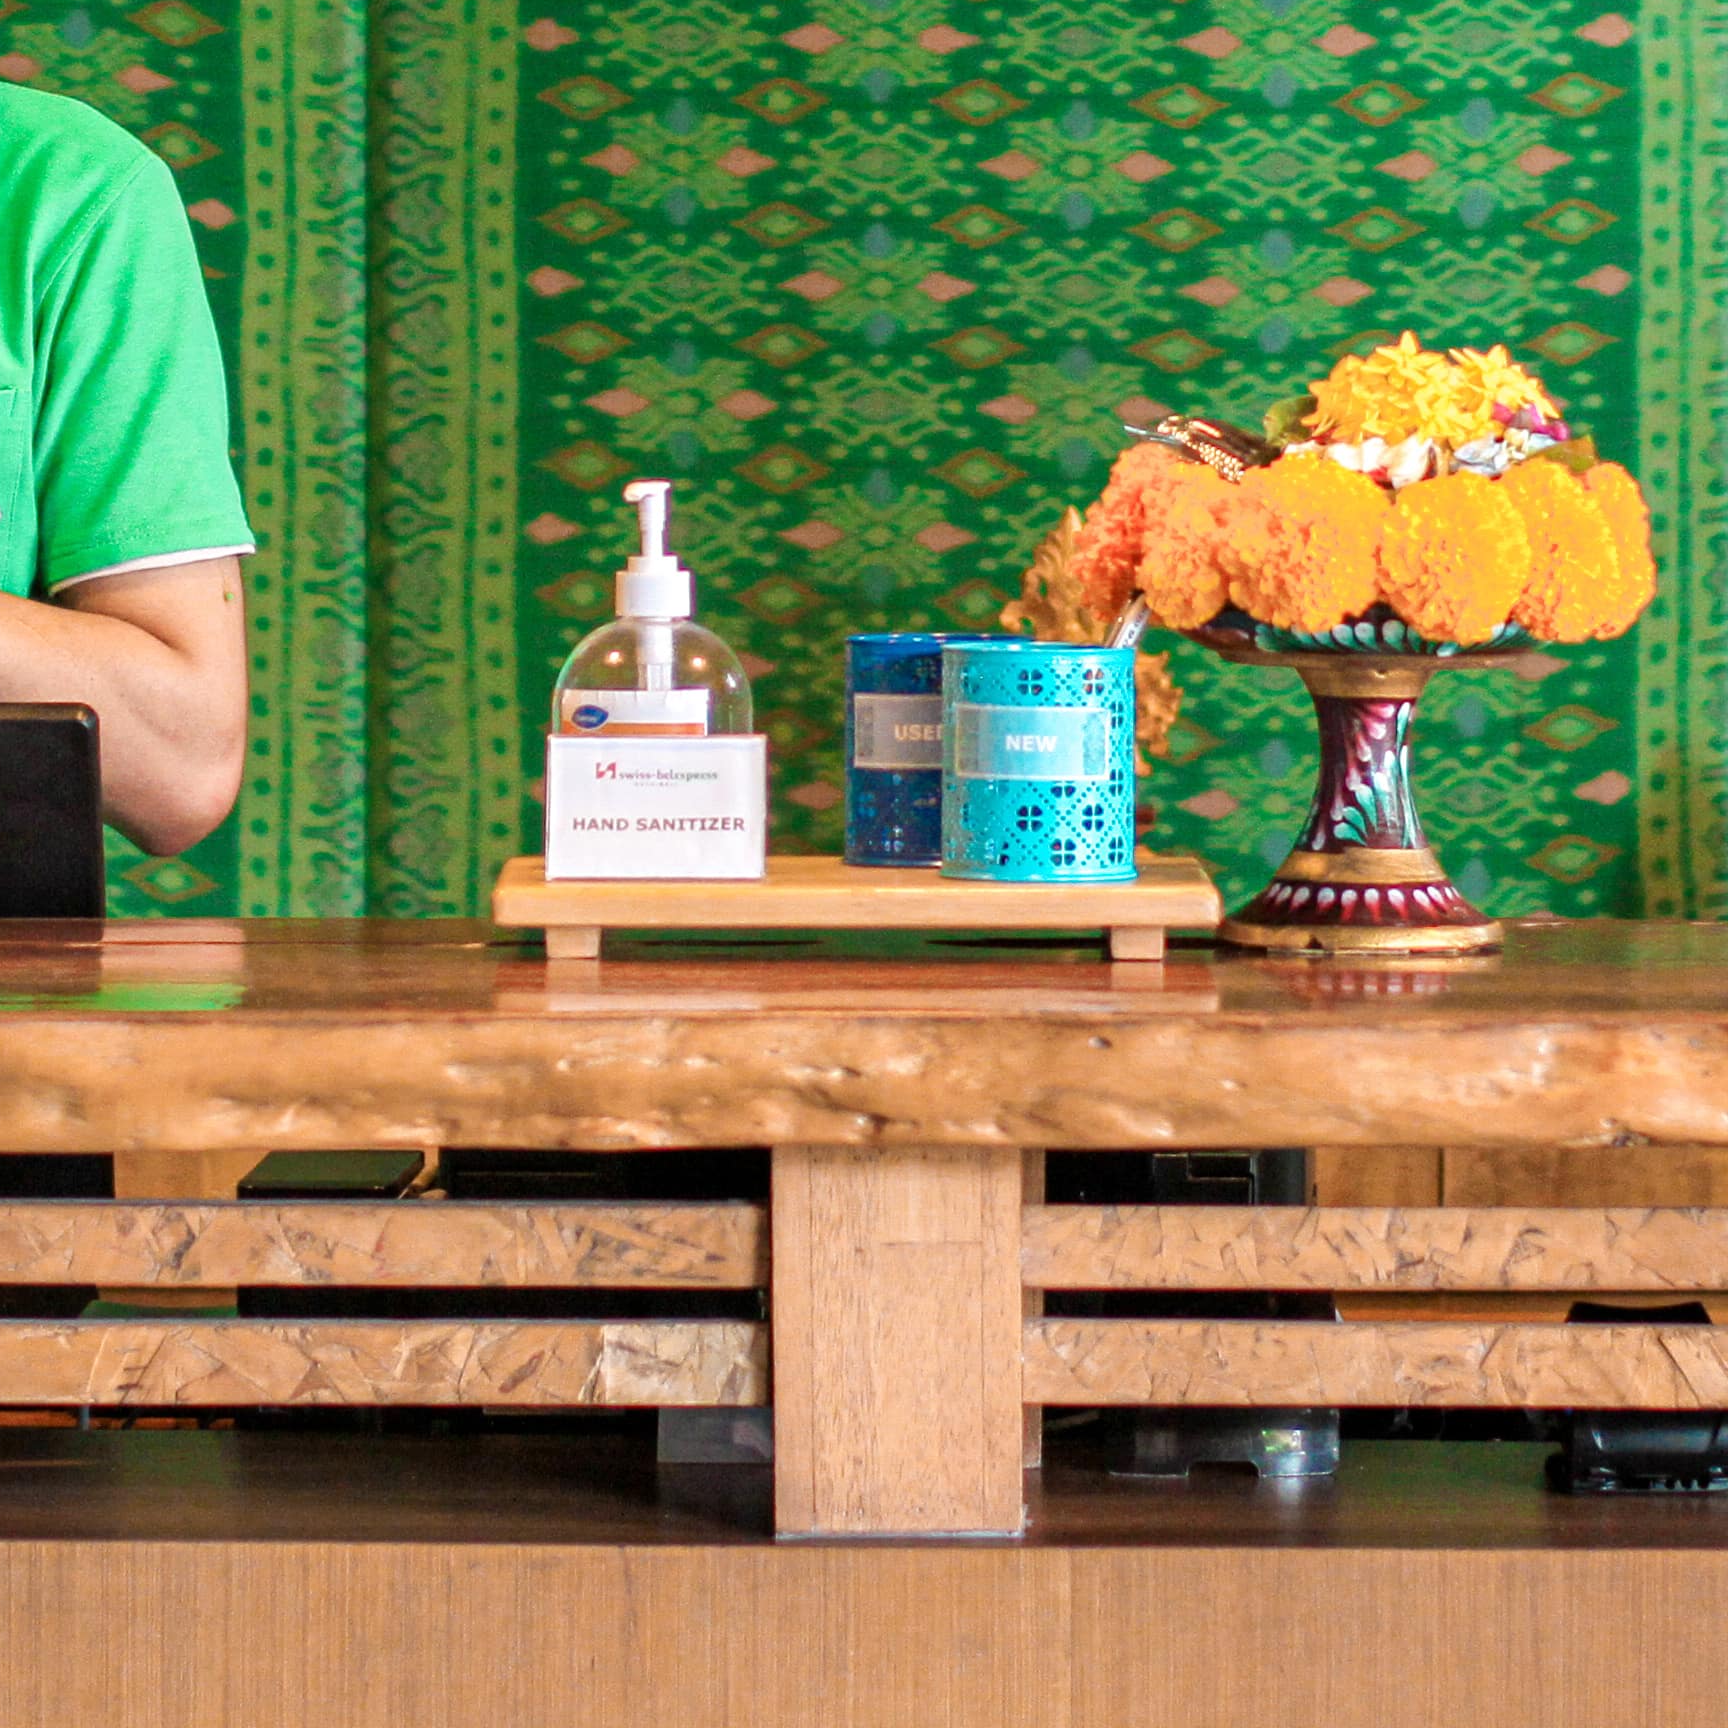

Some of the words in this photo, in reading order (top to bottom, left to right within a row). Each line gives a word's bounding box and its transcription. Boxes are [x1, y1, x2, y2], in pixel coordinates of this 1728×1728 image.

[1005, 734, 1058, 752] NEW
[572, 817, 629, 831] HAND
[635, 816, 746, 831] SANITIZER
